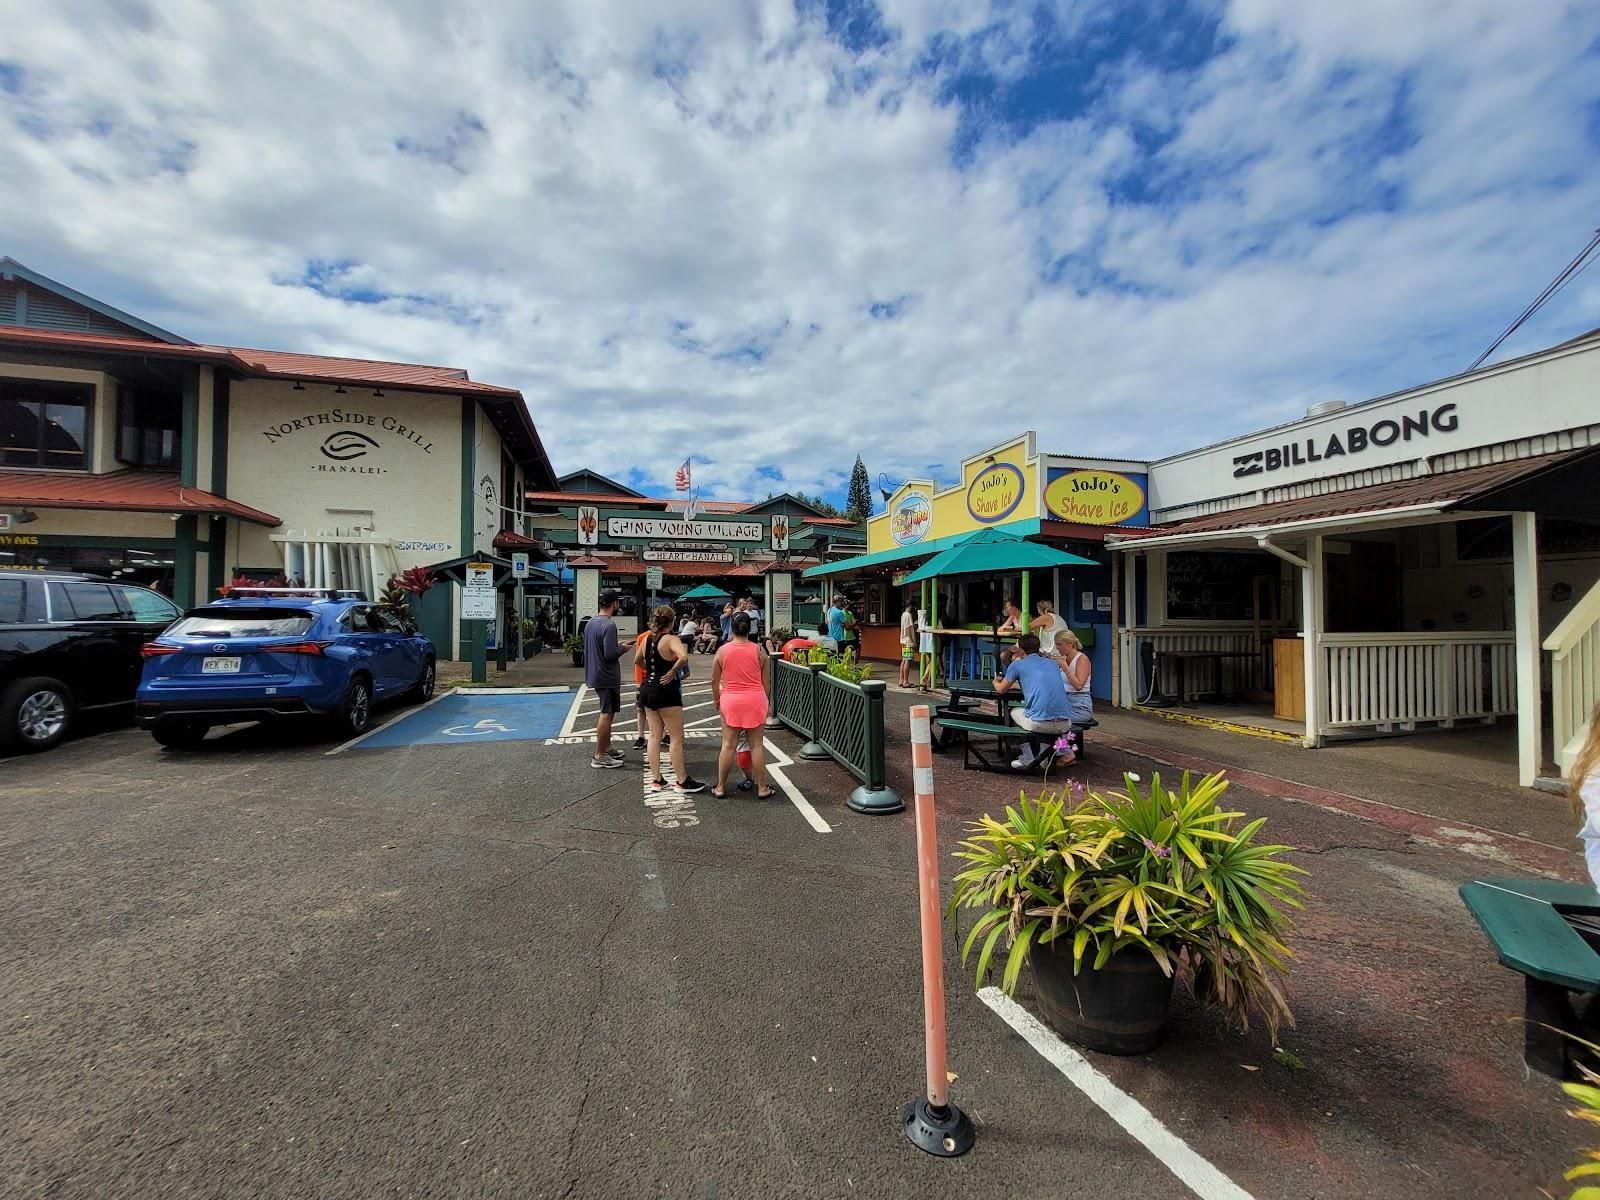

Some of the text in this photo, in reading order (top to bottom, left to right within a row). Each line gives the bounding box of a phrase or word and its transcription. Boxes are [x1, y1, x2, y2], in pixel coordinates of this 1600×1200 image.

[381, 416, 436, 454] GRILL
[1265, 403, 1458, 472] BILLABONG
[318, 464, 381, 474] HANALEI
[981, 472, 1008, 493] JoJo's
[1071, 476, 1121, 494] JoJo's
[976, 491, 1012, 513] Shave Ice
[1060, 497, 1129, 518] Shave Ice
[611, 521, 759, 538] CHING YOUNG VILLAGE
[398, 541, 445, 551] ENTRANCE
[656, 552, 685, 560] HEART
[692, 553, 730, 561] HANALEI
[543, 737, 583, 745] NO
